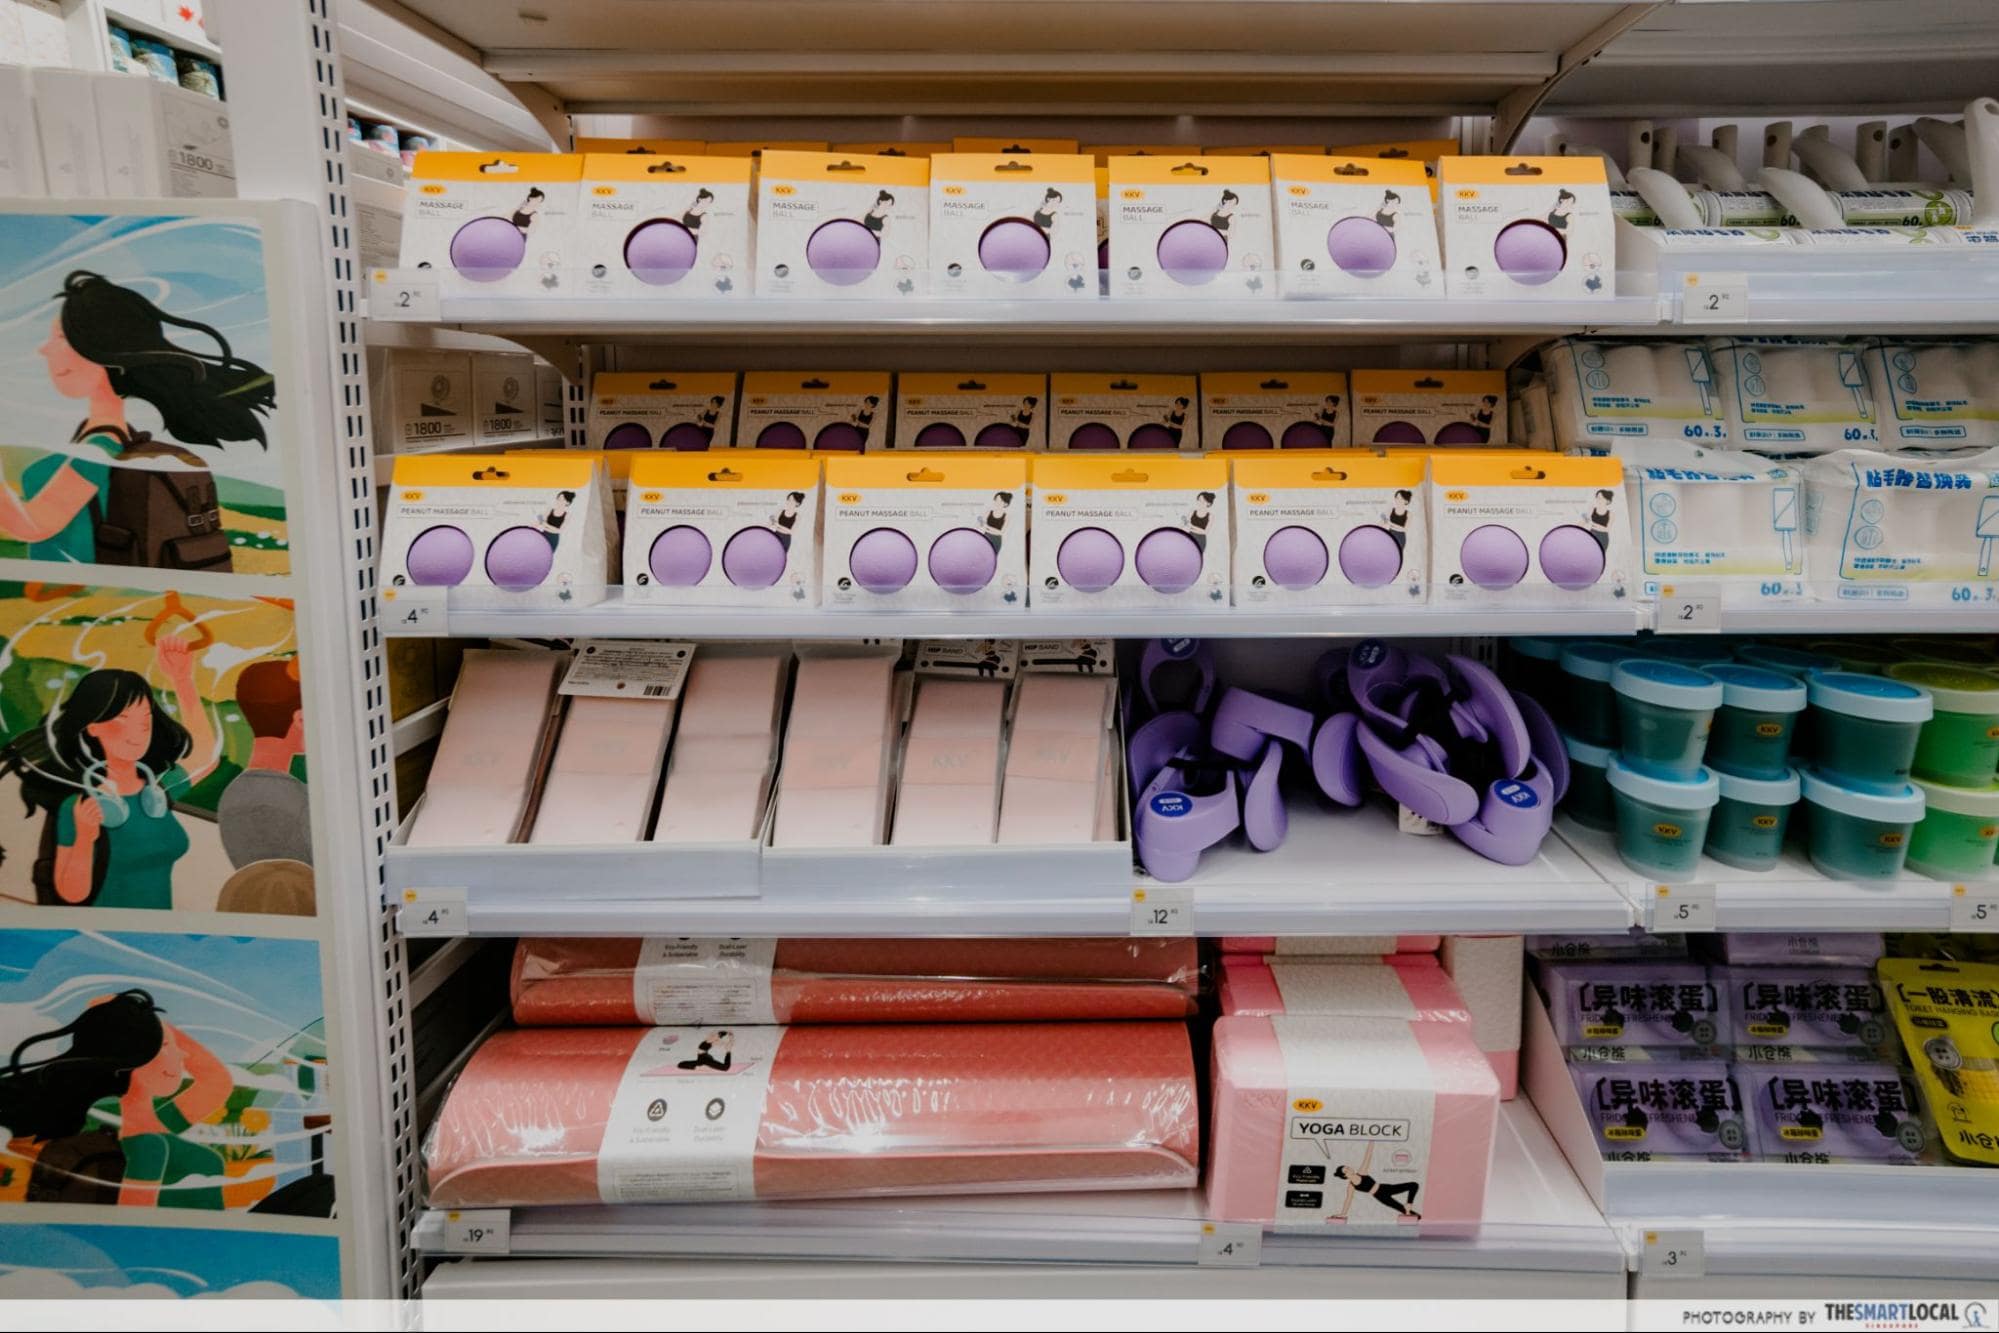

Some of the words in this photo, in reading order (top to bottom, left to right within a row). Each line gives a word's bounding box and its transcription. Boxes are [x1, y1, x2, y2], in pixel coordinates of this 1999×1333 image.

[178, 150, 214, 170] 1800
[772, 202, 816, 211] MASSAGE
[943, 202, 985, 210] MASSAGE
[1290, 202, 1330, 210] MASSAGE
[400, 292, 410, 307] 2
[1709, 294, 1719, 310] 2
[414, 422, 442, 434] 1800
[489, 419, 512, 430] 1800
[408, 608, 418, 624] 4
[1683, 605, 1693, 619] 2
[428, 910, 439, 924] 4
[1154, 909, 1168, 924] 12
[1679, 904, 1689, 919] 5
[1976, 904, 1987, 919] 5
[1299, 1123, 1344, 1135] YOGA
[1350, 1124, 1402, 1136] BLOCK
[469, 1229, 483, 1242] 19
[1223, 1243, 1233, 1256] 4
[1667, 1251, 1677, 1265] 3
